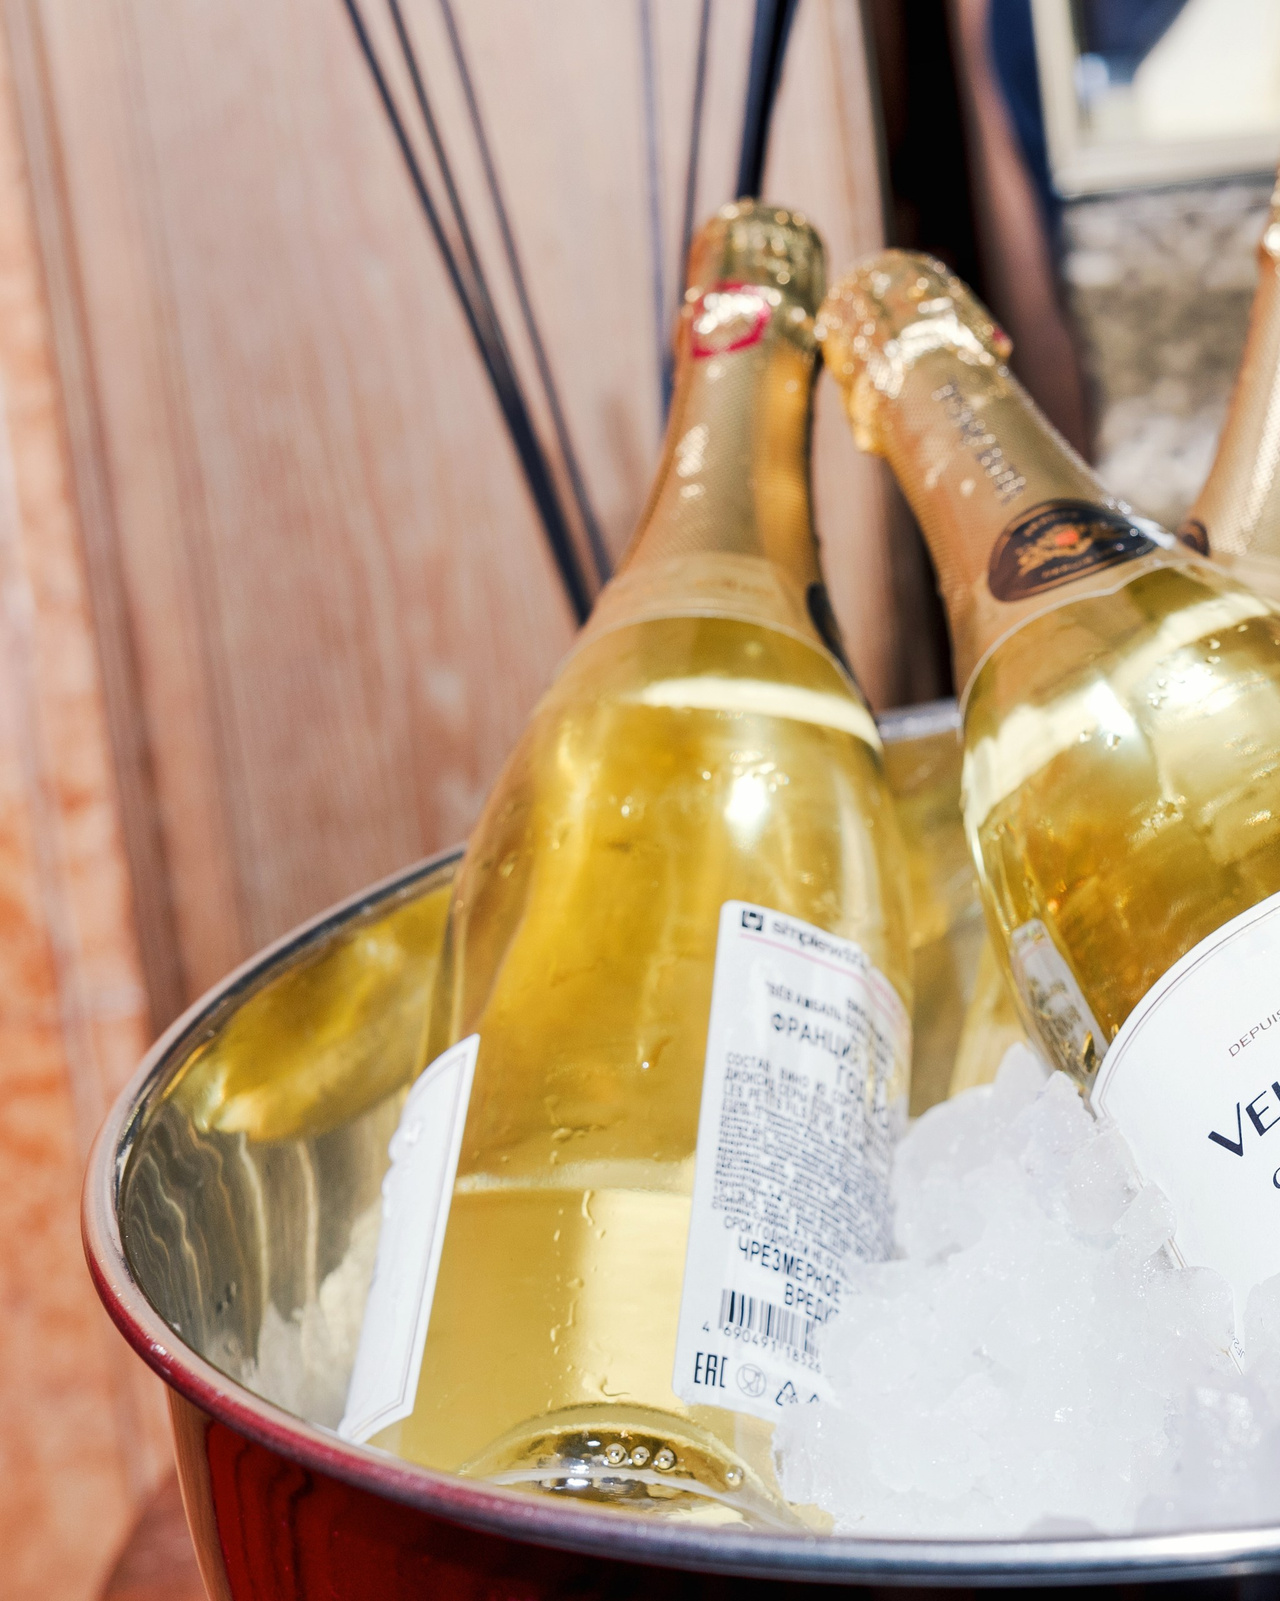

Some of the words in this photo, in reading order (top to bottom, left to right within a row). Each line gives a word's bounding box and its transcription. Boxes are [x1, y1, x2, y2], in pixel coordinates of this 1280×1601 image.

[738, 1235, 841, 1304] ЧРЕЗМЕРНОЕ
[702, 1321, 710, 1332] 4
[723, 1325, 776, 1352] 690491
[786, 1346, 822, 1374] 18526
